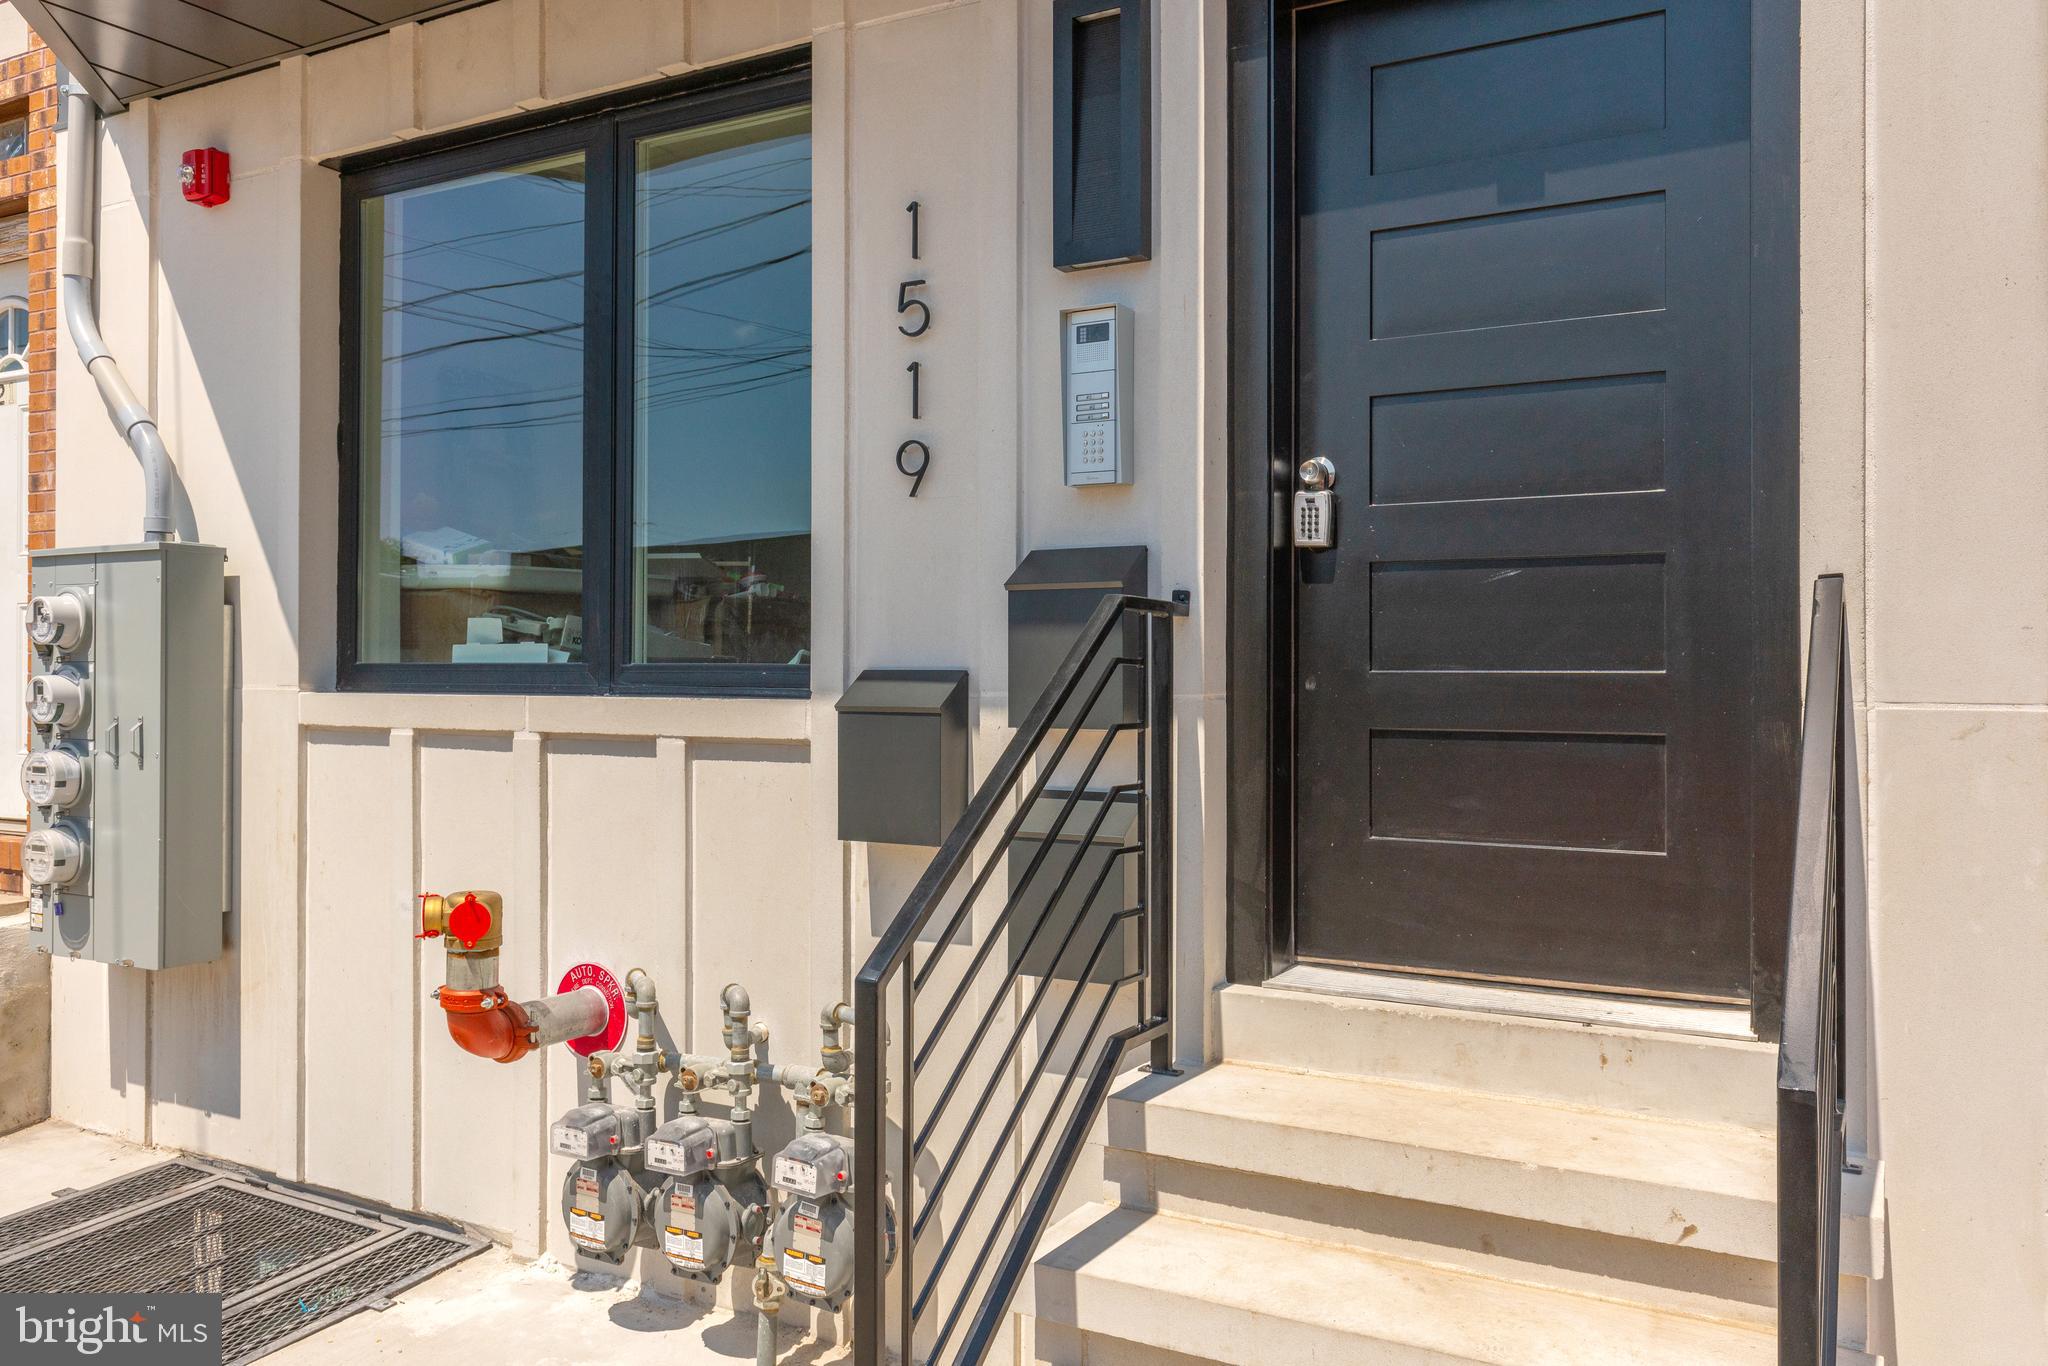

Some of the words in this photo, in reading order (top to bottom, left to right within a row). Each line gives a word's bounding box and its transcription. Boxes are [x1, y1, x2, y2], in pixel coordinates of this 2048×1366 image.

[896, 200, 931, 498] 1519
[570, 965, 595, 983] AUTO.
[598, 970, 620, 1001] SPKR.
